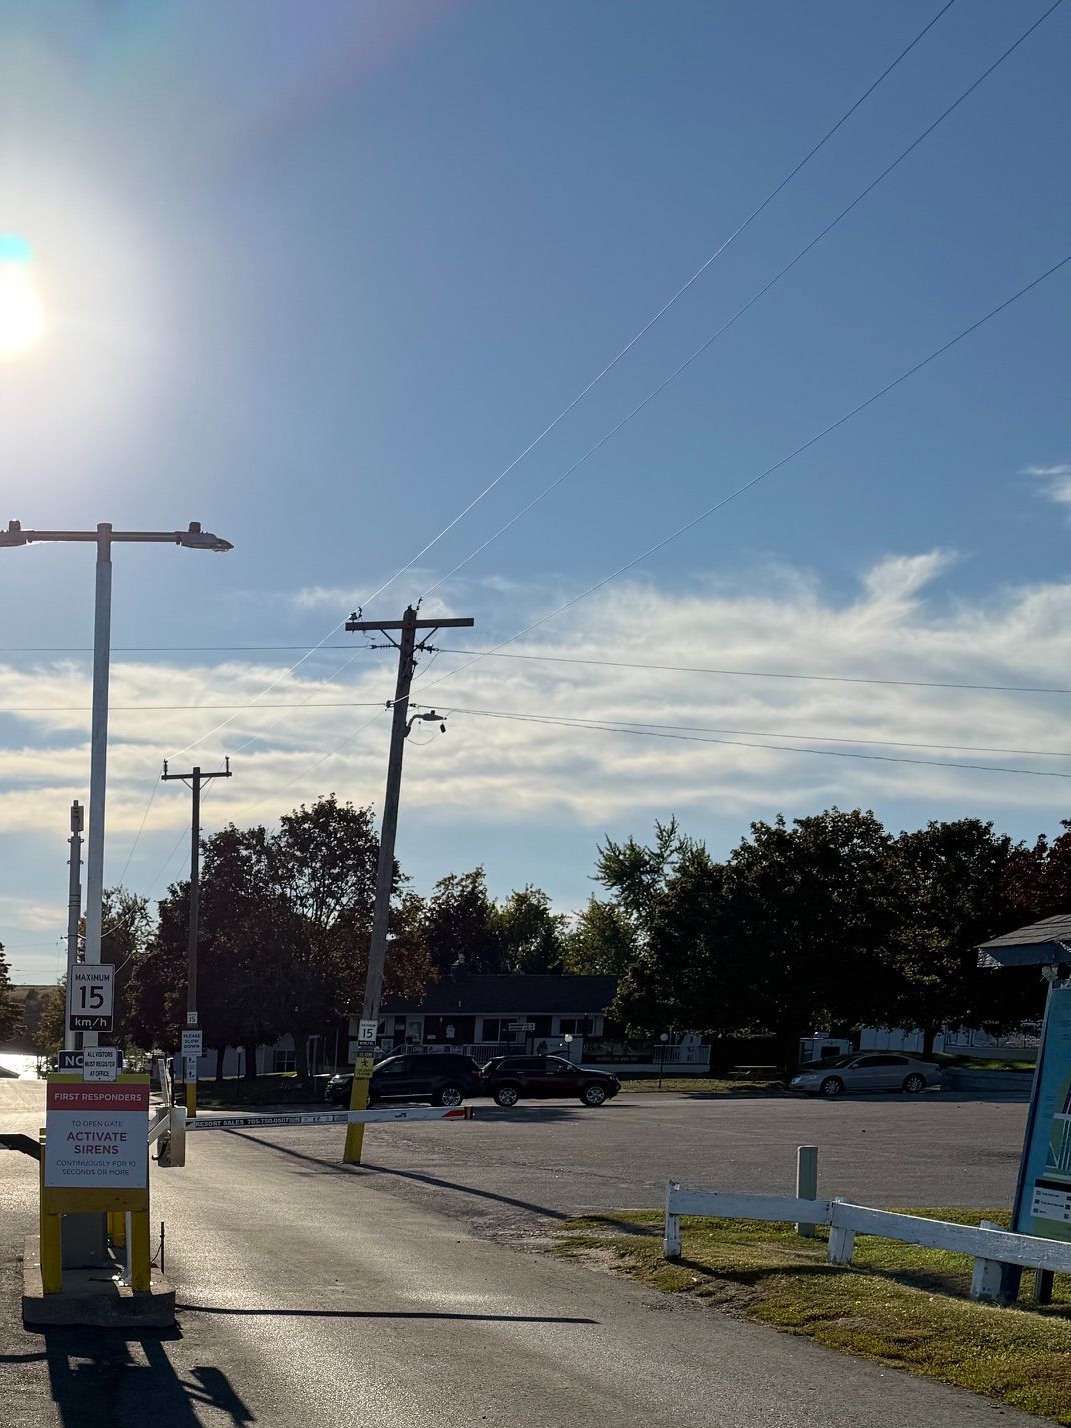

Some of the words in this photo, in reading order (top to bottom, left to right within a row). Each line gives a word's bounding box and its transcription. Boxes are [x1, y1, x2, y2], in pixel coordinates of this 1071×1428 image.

[79, 985, 104, 1009] 15
[75, 1017, 107, 1027] km/h
[363, 1028, 373, 1039] 15
[82, 1093, 142, 1101] RESPONDERS
[66, 1132, 128, 1141] ACTIVATE
[74, 1145, 119, 1154] SIRENS
